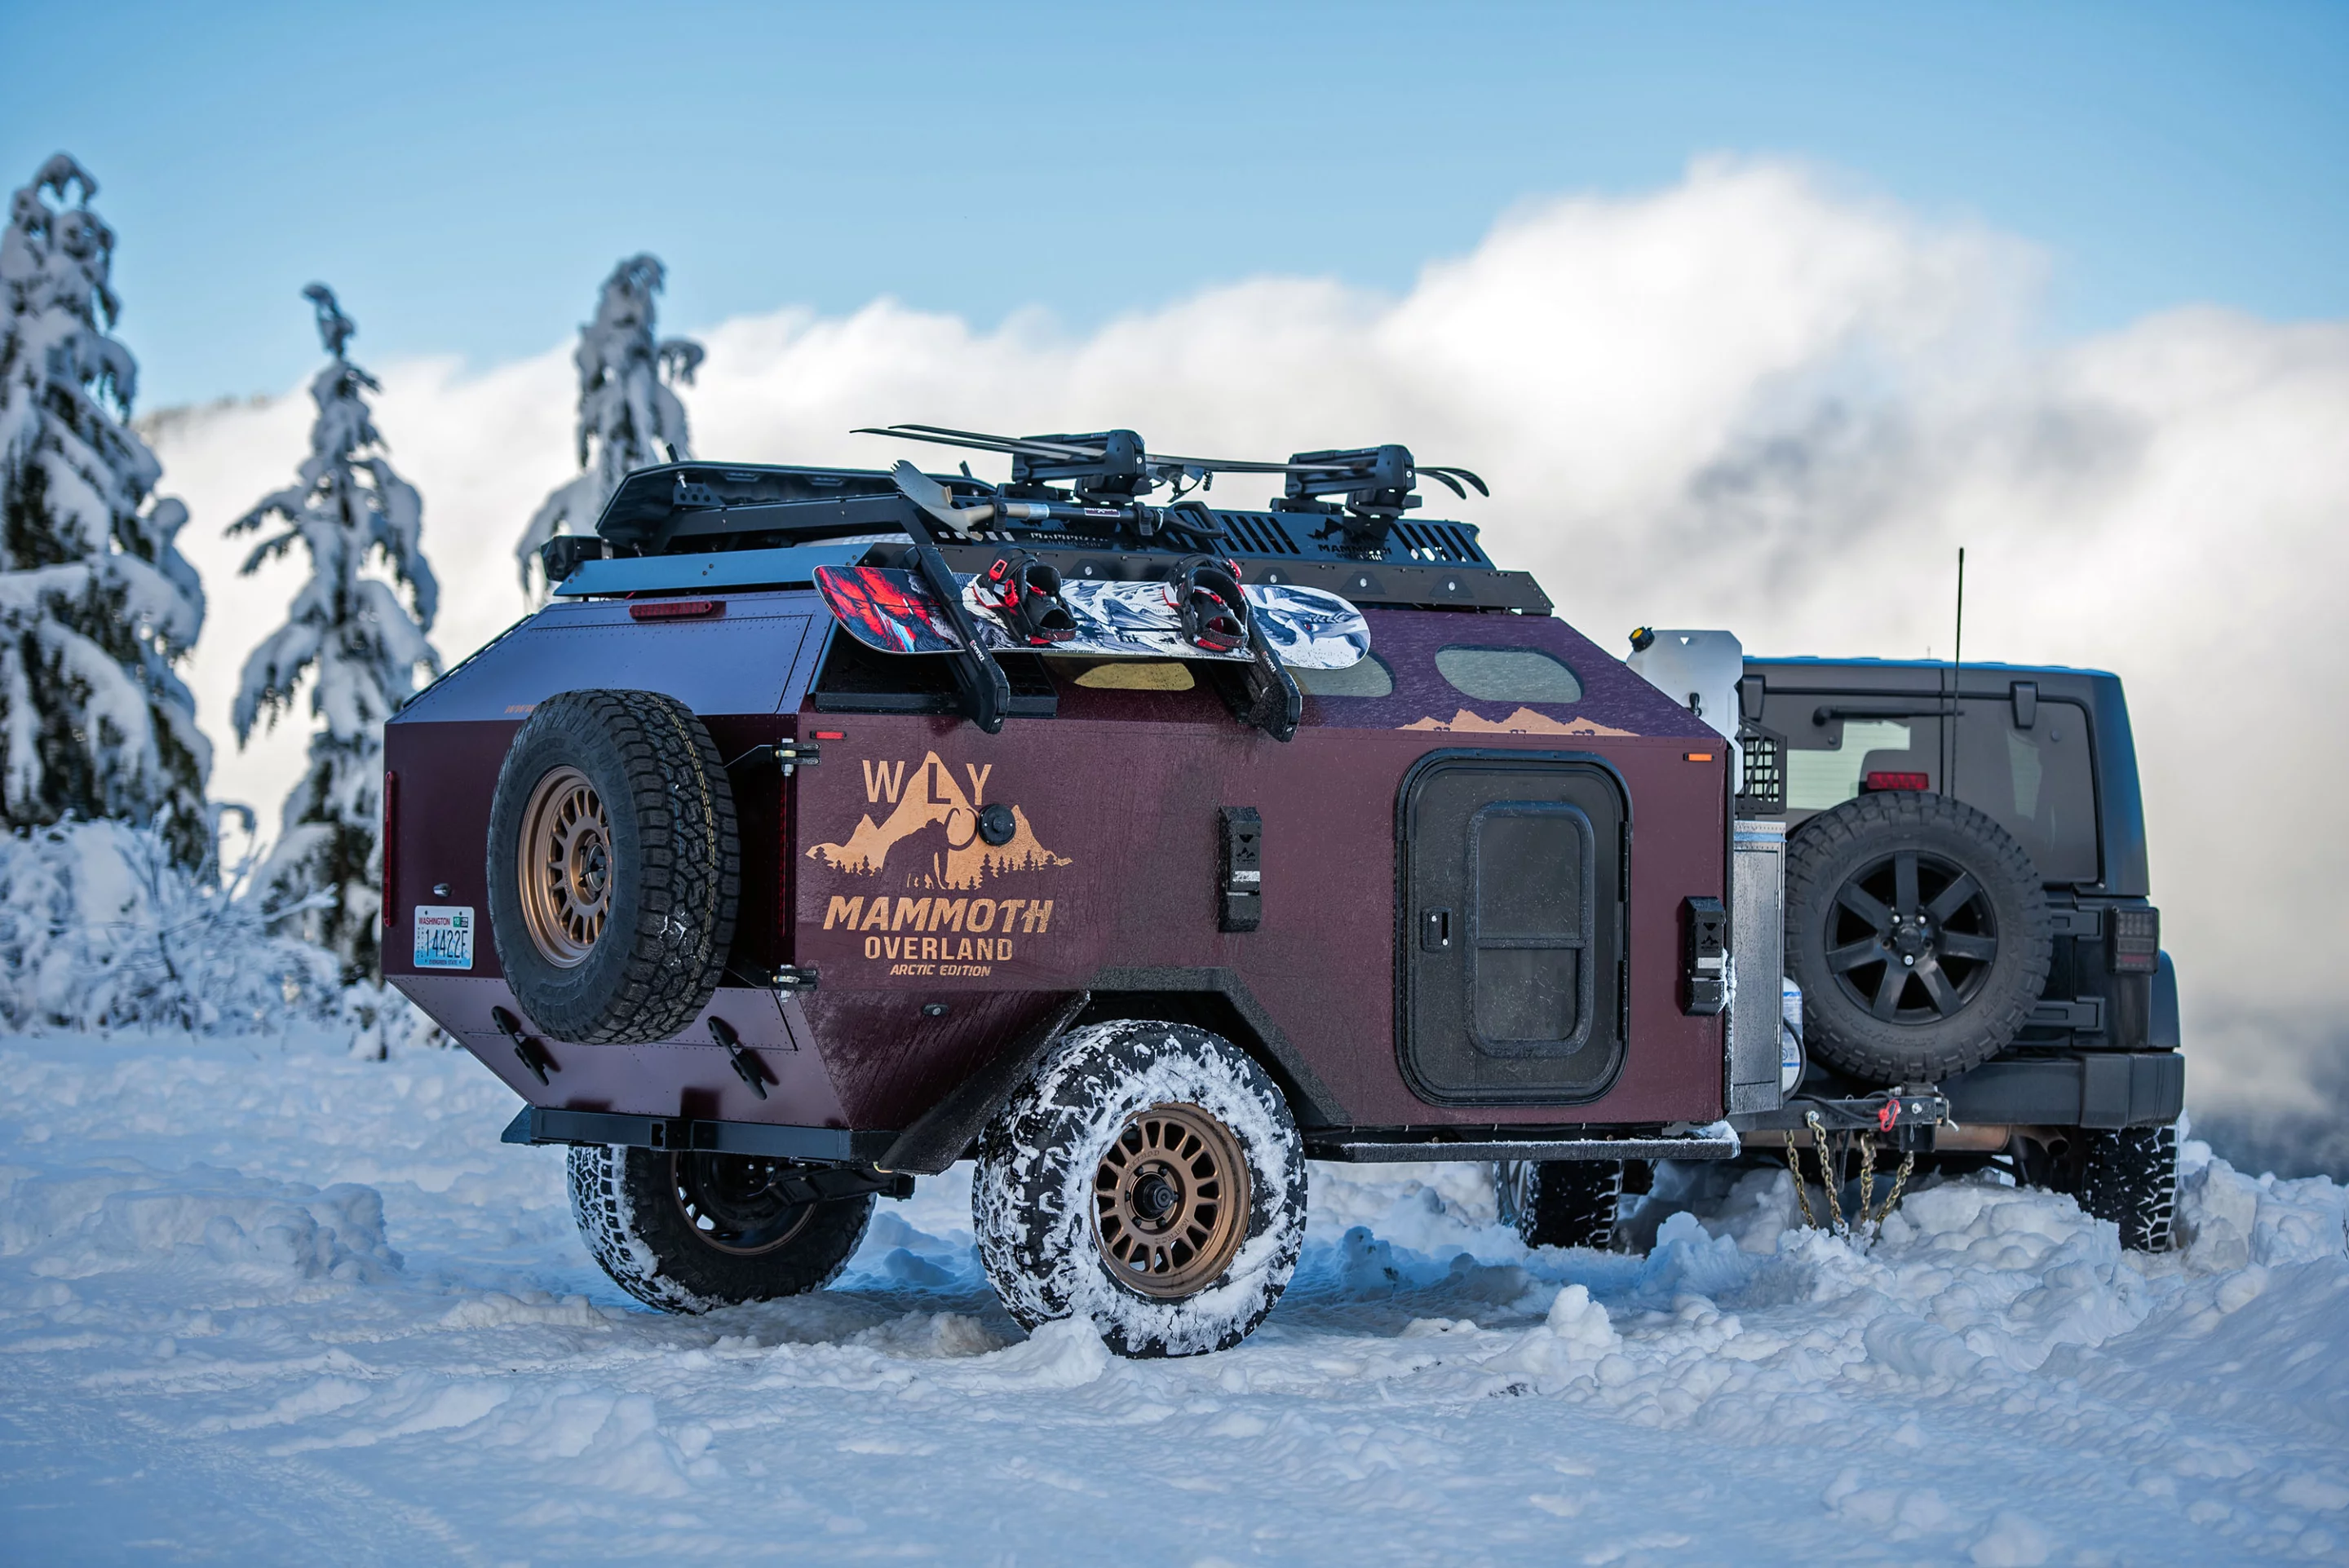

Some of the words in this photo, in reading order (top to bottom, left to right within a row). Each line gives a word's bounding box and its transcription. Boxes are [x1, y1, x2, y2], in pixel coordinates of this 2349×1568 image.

[418, 917, 450, 925] WASHINGTON
[823, 895, 1054, 934] MAMMOTH
[426, 929, 468, 959] 14422F
[865, 936, 1013, 961] OVERLAND
[890, 964, 936, 976] ARCTIC
[940, 965, 992, 977] EDITION
